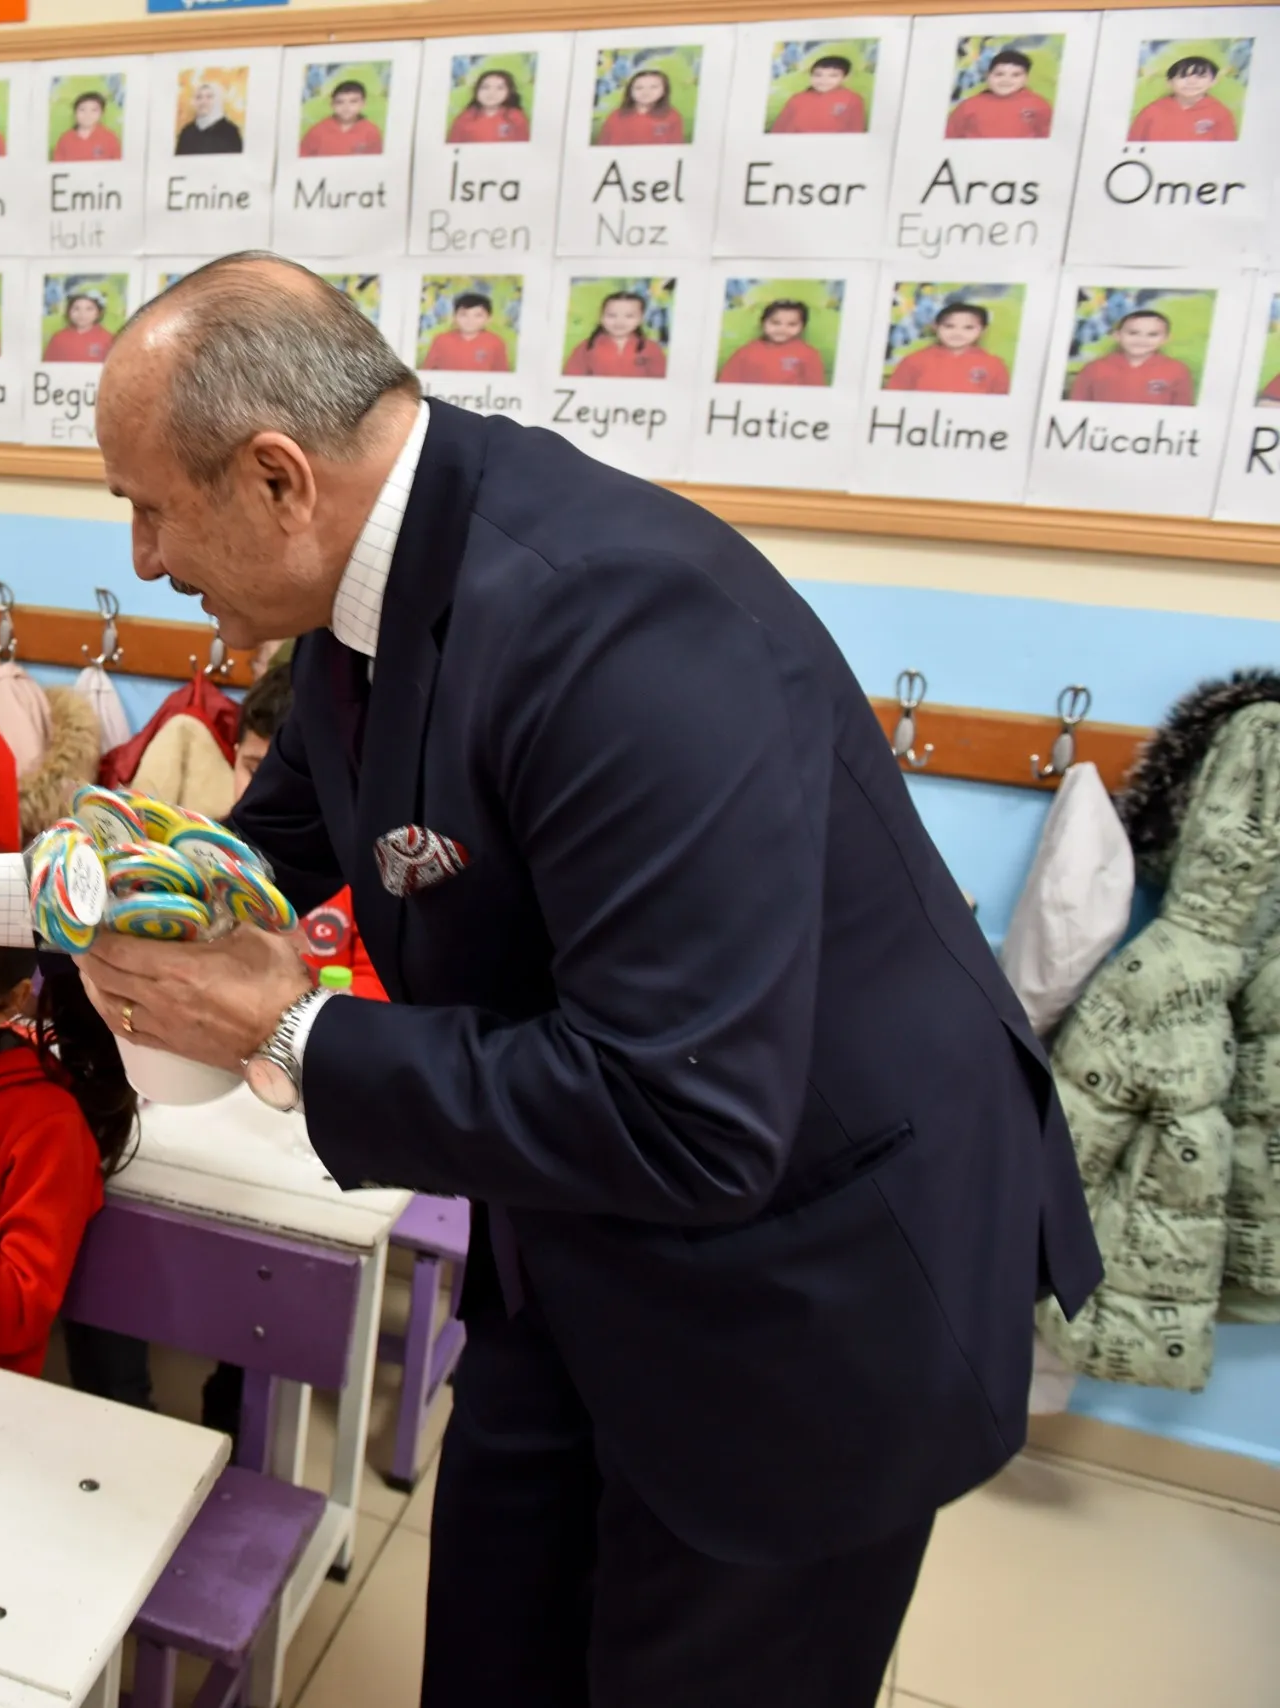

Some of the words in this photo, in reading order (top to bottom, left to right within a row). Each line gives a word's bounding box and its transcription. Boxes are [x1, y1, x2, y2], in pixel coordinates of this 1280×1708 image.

[51, 173, 122, 212] Emin
[166, 176, 250, 211] Emine
[293, 178, 387, 209] Murat
[449, 147, 520, 202] İsra
[592, 158, 684, 203] Asel
[743, 162, 866, 206] Ensar
[920, 158, 1040, 206] Aras
[1104, 146, 1246, 206] Ömer
[49, 218, 106, 251] Halit
[427, 208, 531, 252] Beren
[595, 208, 669, 247] Naz
[896, 212, 1039, 259] Eymen
[32, 372, 96, 421] Begü
[552, 388, 668, 440] Zeynep
[706, 399, 831, 441] Hatice
[867, 404, 1010, 452] Halime
[1044, 414, 1201, 457] Mücahit
